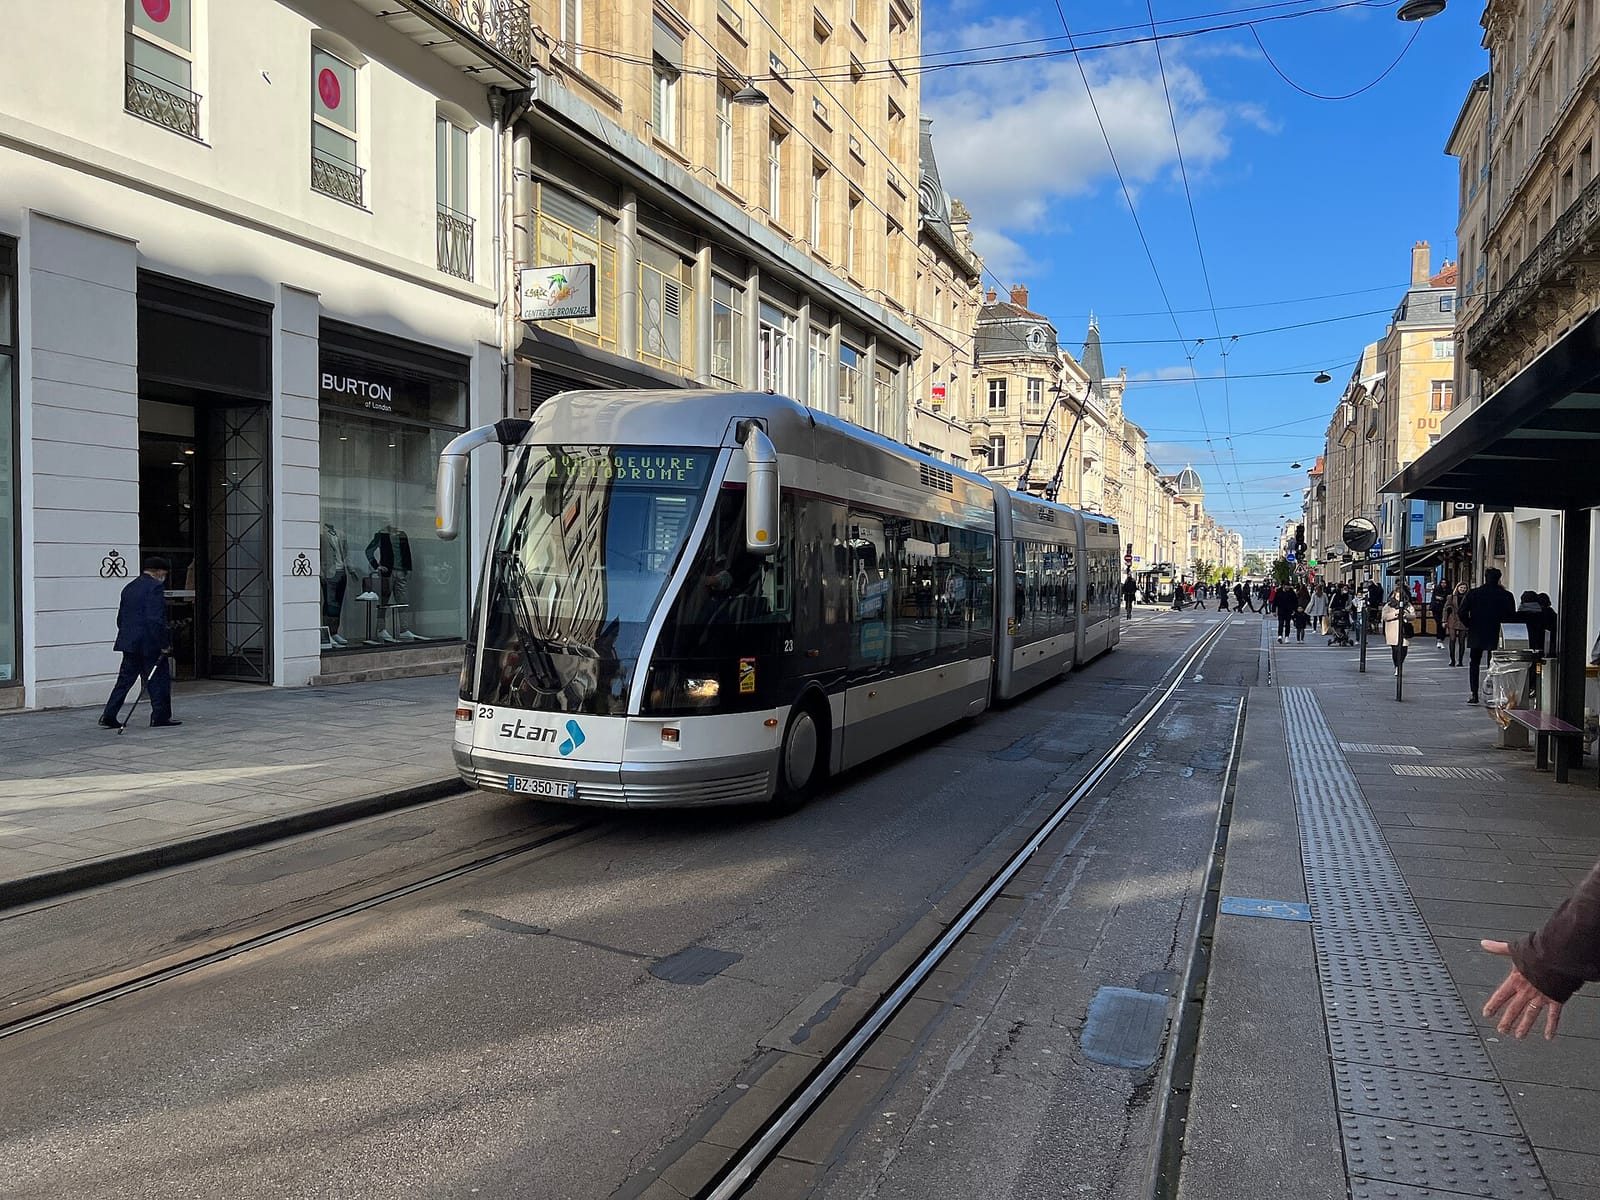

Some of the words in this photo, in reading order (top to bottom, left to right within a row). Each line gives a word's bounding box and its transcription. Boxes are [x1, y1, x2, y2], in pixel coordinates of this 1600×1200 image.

[524, 308, 546, 318] CENTRE
[547, 308, 556, 317] DE
[557, 305, 589, 317] BRONZAGE
[322, 373, 392, 401] BURTON
[372, 402, 392, 411] London
[784, 640, 794, 652] 23
[478, 707, 494, 719] 23
[499, 719, 558, 743] stan
